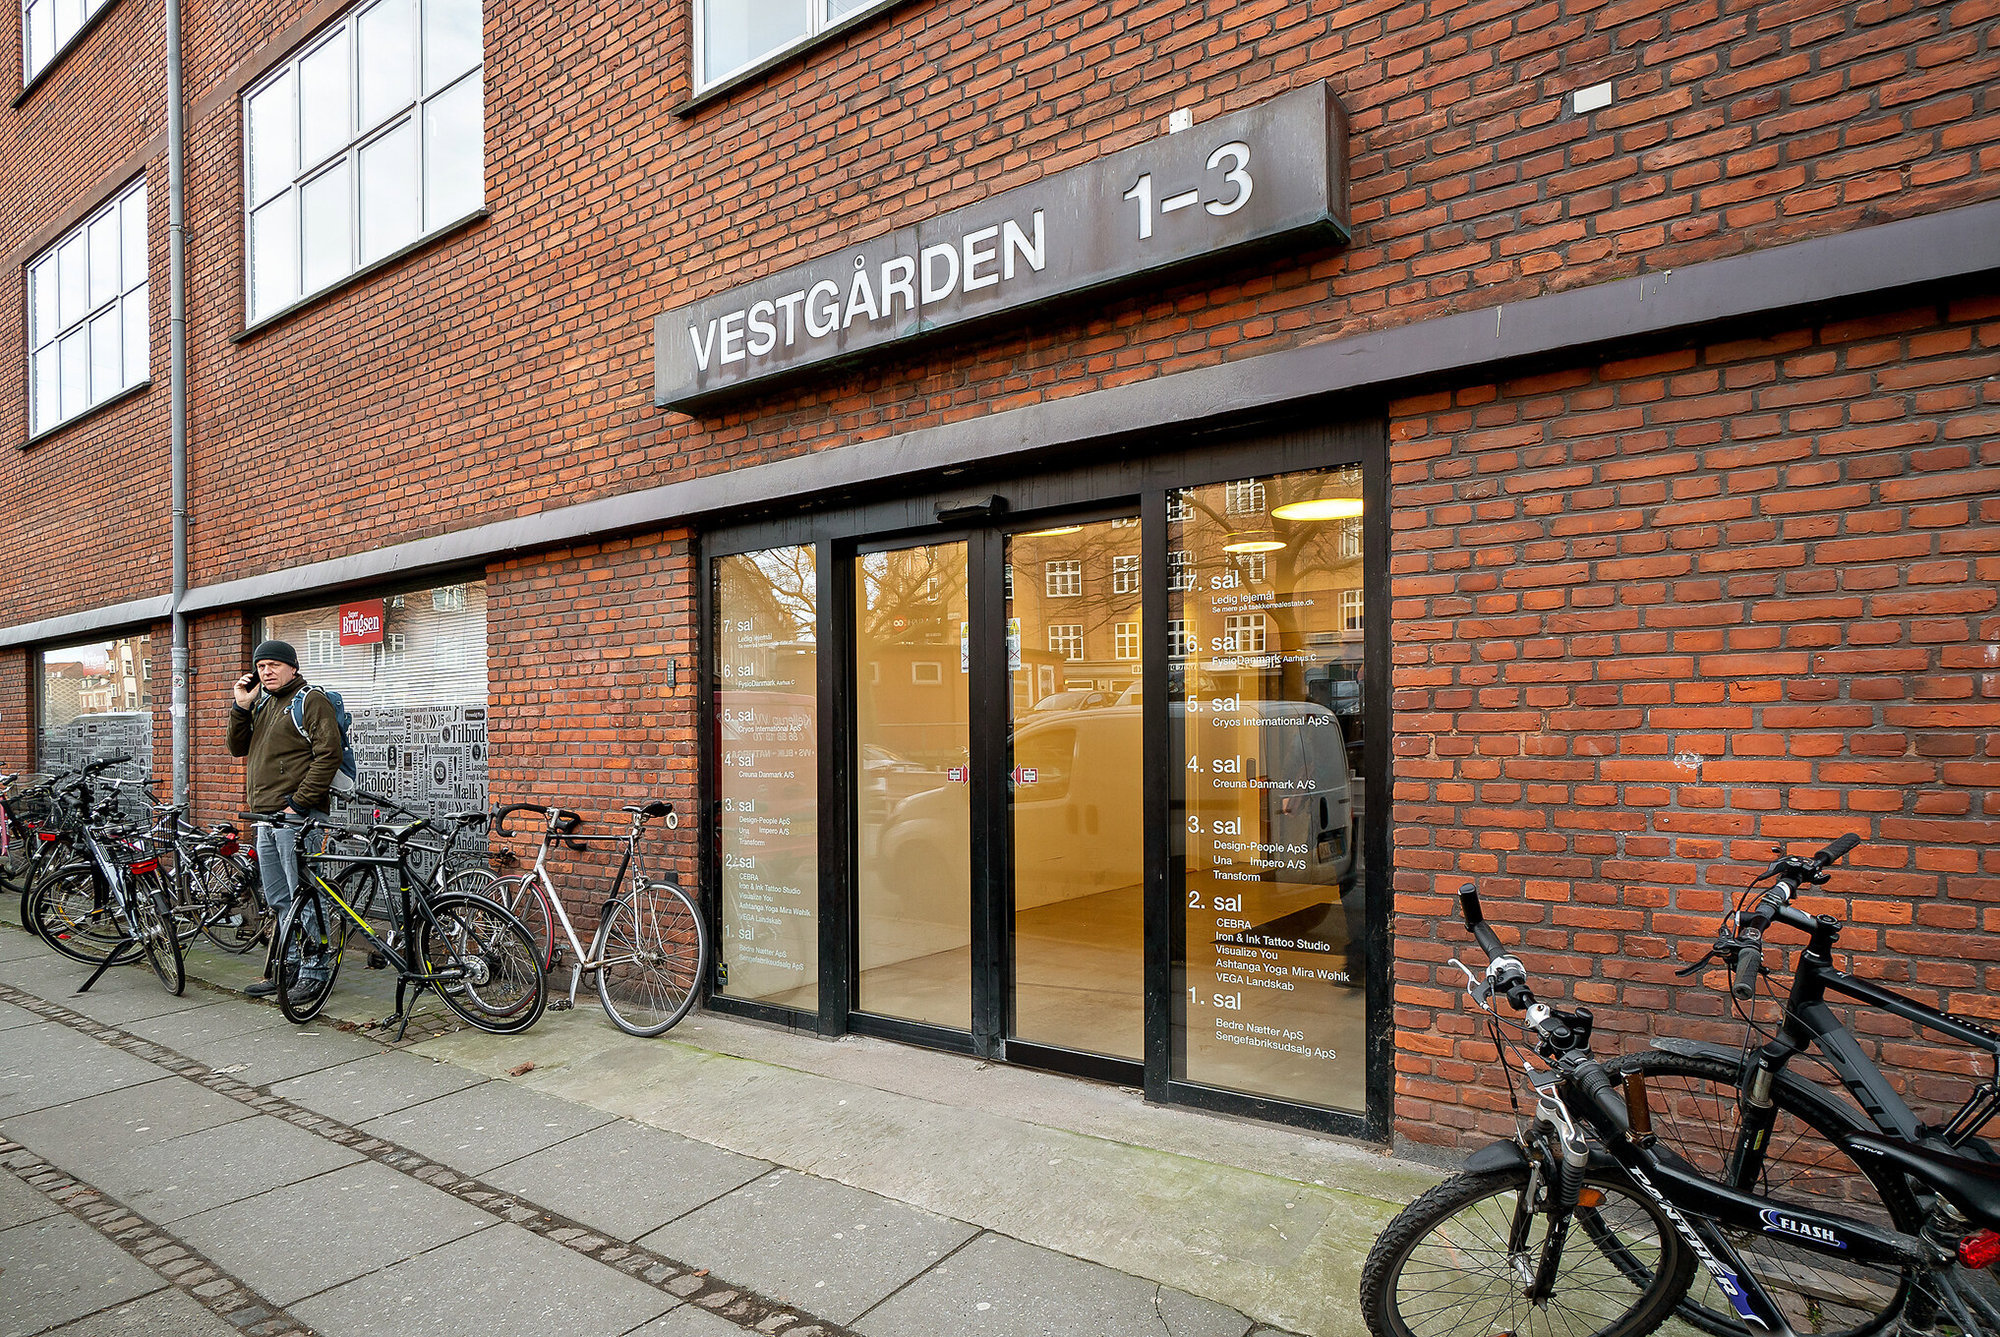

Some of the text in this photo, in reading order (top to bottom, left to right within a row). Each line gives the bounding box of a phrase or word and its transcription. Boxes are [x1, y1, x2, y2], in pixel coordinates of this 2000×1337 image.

[688, 140, 1254, 372] VESTGÅRDEN 1-3
[1186, 570, 1239, 592] 7. sal
[1211, 591, 1275, 606] Ledig lejemål
[343, 614, 379, 636] Brugsen
[724, 617, 753, 632] 7. sal
[1186, 632, 1239, 652] 6. sal
[1212, 654, 1281, 667] FysioDanmark
[1282, 654, 1309, 662] Aarhus
[724, 662, 754, 677] 6. sal
[1187, 693, 1240, 712] 5. sal
[724, 707, 754, 722] 5. sal
[1212, 715, 1329, 728] Cryos International ApS
[451, 723, 485, 743] Tilbud
[755, 724, 788, 732] International
[355, 748, 387, 765] nglamark
[428, 744, 462, 755] Velkommen
[724, 753, 754, 767] 4. sal
[1187, 754, 1241, 773] 4. sal
[739, 770, 795, 779] Creuna Danmark A/S
[358, 771, 396, 798] Økologi
[454, 784, 478, 799] Mælk
[1213, 778, 1316, 790] Creuna Danmark A/S
[725, 798, 754, 812] 3. sal
[348, 808, 374, 825] Tilbud
[739, 816, 791, 826] Design-People ApS
[739, 827, 790, 836] Una Impero A/S
[1188, 816, 1241, 835] 3. sal
[739, 838, 765, 846] Transform
[1213, 840, 1284, 854] Design-People
[1287, 843, 1308, 855] ApS
[739, 855, 754, 868] sal
[1213, 855, 1306, 870] Una Impero A/S
[739, 873, 759, 881] CEBRA
[1213, 870, 1261, 882] Transform
[765, 885, 782, 893] Tattoo
[783, 886, 801, 895] Studio
[765, 904, 778, 913] Yoga
[1188, 891, 1242, 912] 2. sal
[1216, 918, 1252, 930] CEBRA
[725, 925, 754, 940] 1. sal
[1215, 931, 1331, 951] Iron & Ink Tattoo Studio
[775, 949, 787, 958] ApS
[1215, 944, 1278, 960] Visualize You
[792, 960, 804, 971] ApS
[1215, 959, 1350, 982] Ashtanga Yoga Mira Wøhlk
[1216, 973, 1294, 992] VEGA Landskab
[1188, 987, 1241, 1010] 1. sal
[1216, 1018, 1304, 1041] Bedre Nætter ApS
[1215, 1031, 1336, 1060] Sengefabriksudsalg ApS
[1850, 1143, 1884, 1156] ACTIVE
[1629, 1165, 1739, 1295] PANTHER
[1779, 1216, 1835, 1241] FLASH
